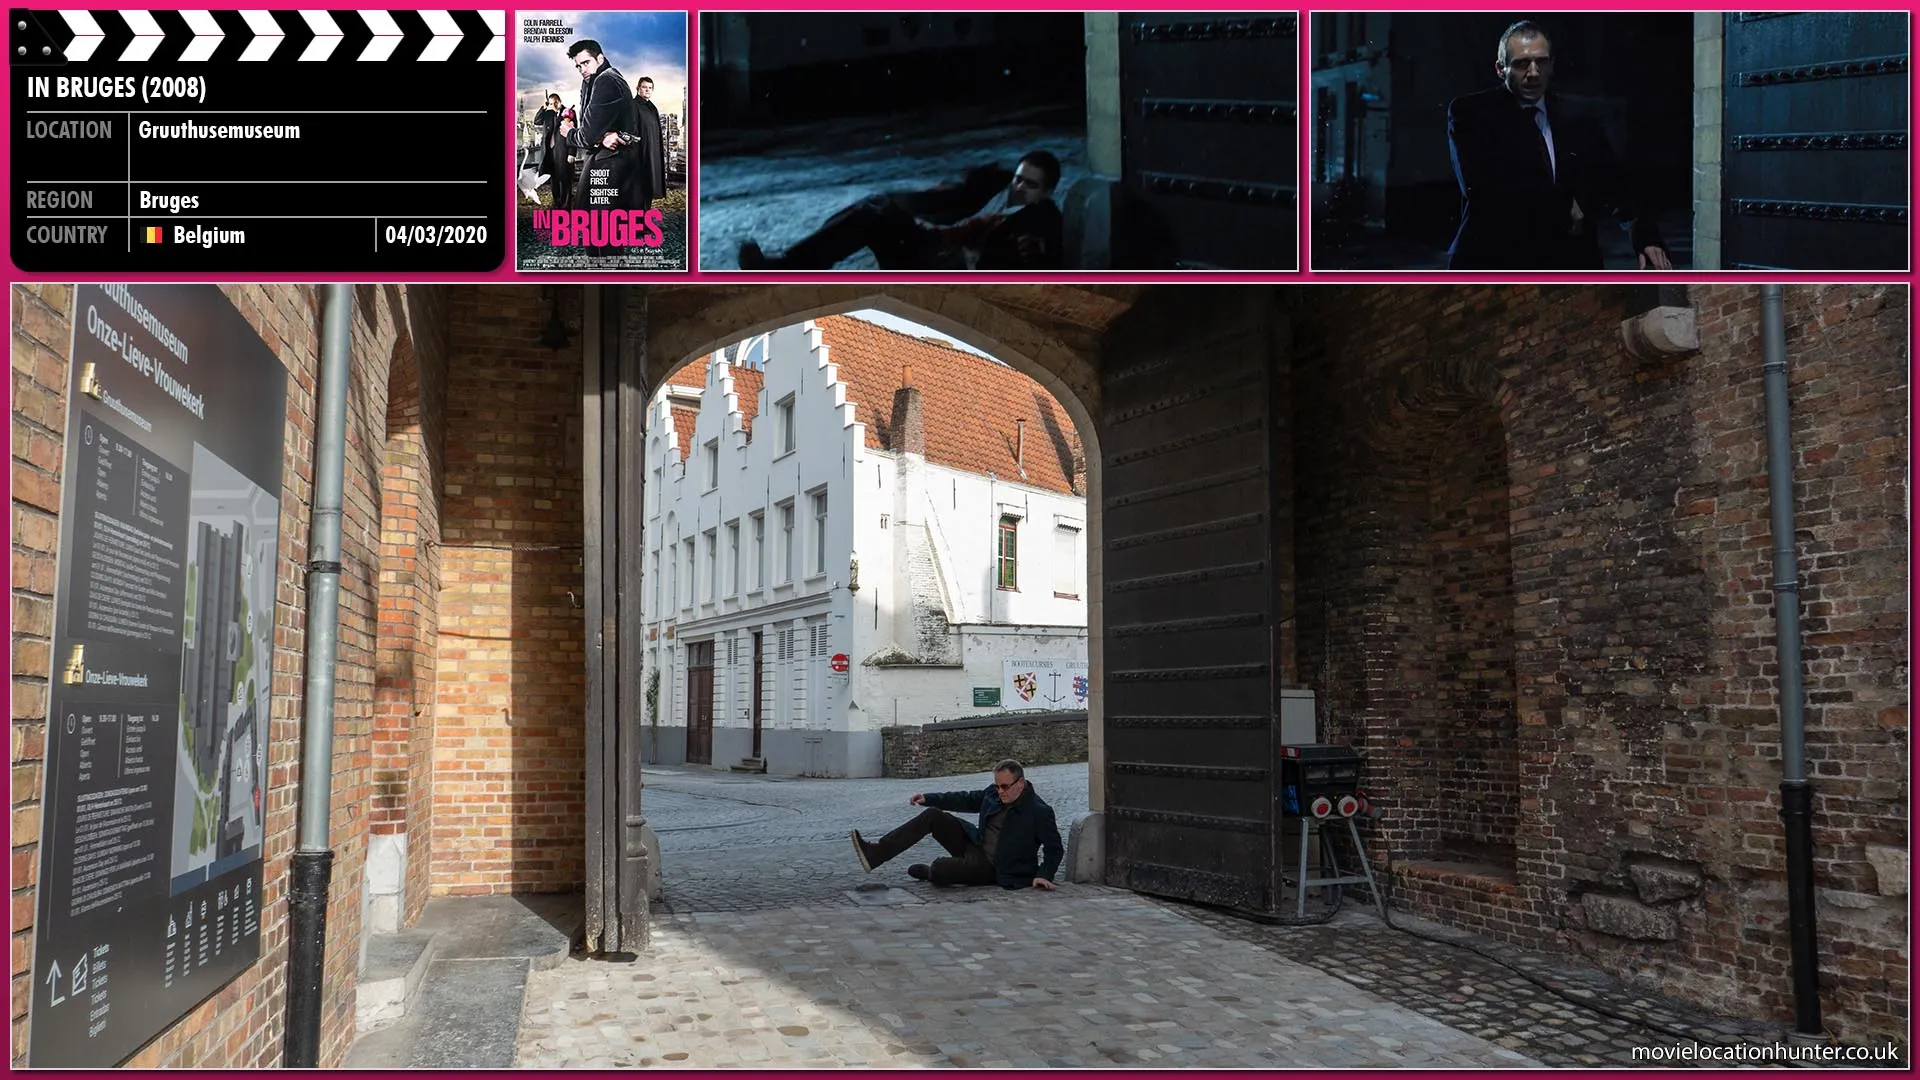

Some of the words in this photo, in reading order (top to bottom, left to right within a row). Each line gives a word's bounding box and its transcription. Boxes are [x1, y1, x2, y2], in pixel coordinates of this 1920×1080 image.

[523, 19, 538, 27] COLIN
[539, 19, 563, 27] FARRELL
[523, 27, 547, 35] BRENDAN
[548, 27, 573, 35] GLEESON
[523, 35, 541, 43] RALPH
[541, 35, 565, 43] FIENNES
[589, 169, 610, 177] SHOOT
[589, 177, 609, 186] FIRST.
[589, 188, 619, 197] SIGHTSEE
[589, 197, 611, 205] LATER.
[532, 209, 550, 229] IN
[551, 208, 664, 248] BRUGES
[87, 304, 205, 421] Onze-Lieve-Vrouwekerk
[85, 669, 149, 687] Onze-Lieve-Vrouwekerk
